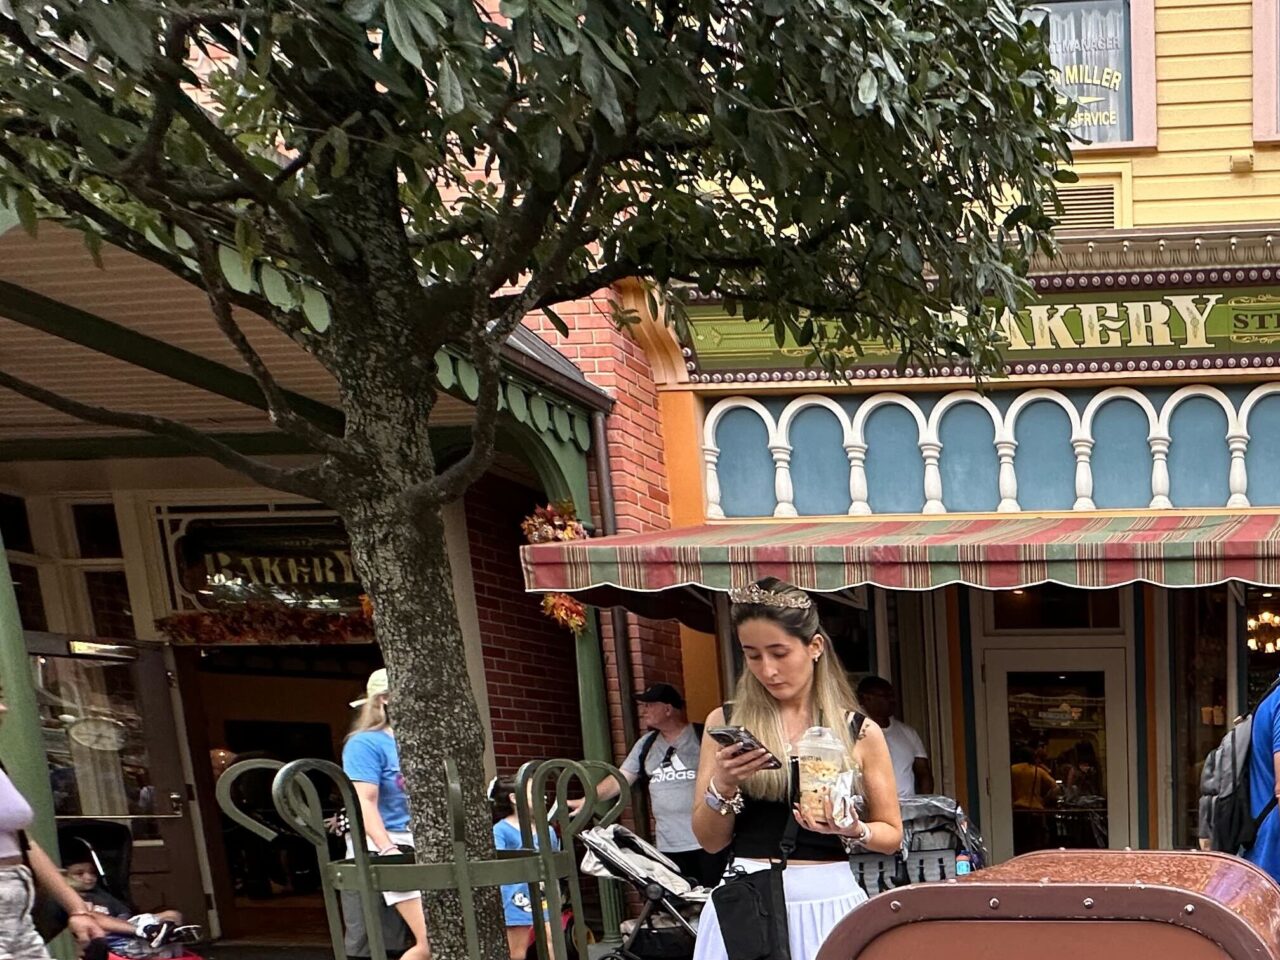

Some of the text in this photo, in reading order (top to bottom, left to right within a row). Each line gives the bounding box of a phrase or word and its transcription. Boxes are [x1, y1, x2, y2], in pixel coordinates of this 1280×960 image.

[1062, 36, 1121, 53] MANAGER
[1065, 64, 1122, 92] MILLER
[1070, 110, 1118, 128] SERVICE
[204, 550, 360, 586] BAKERY
